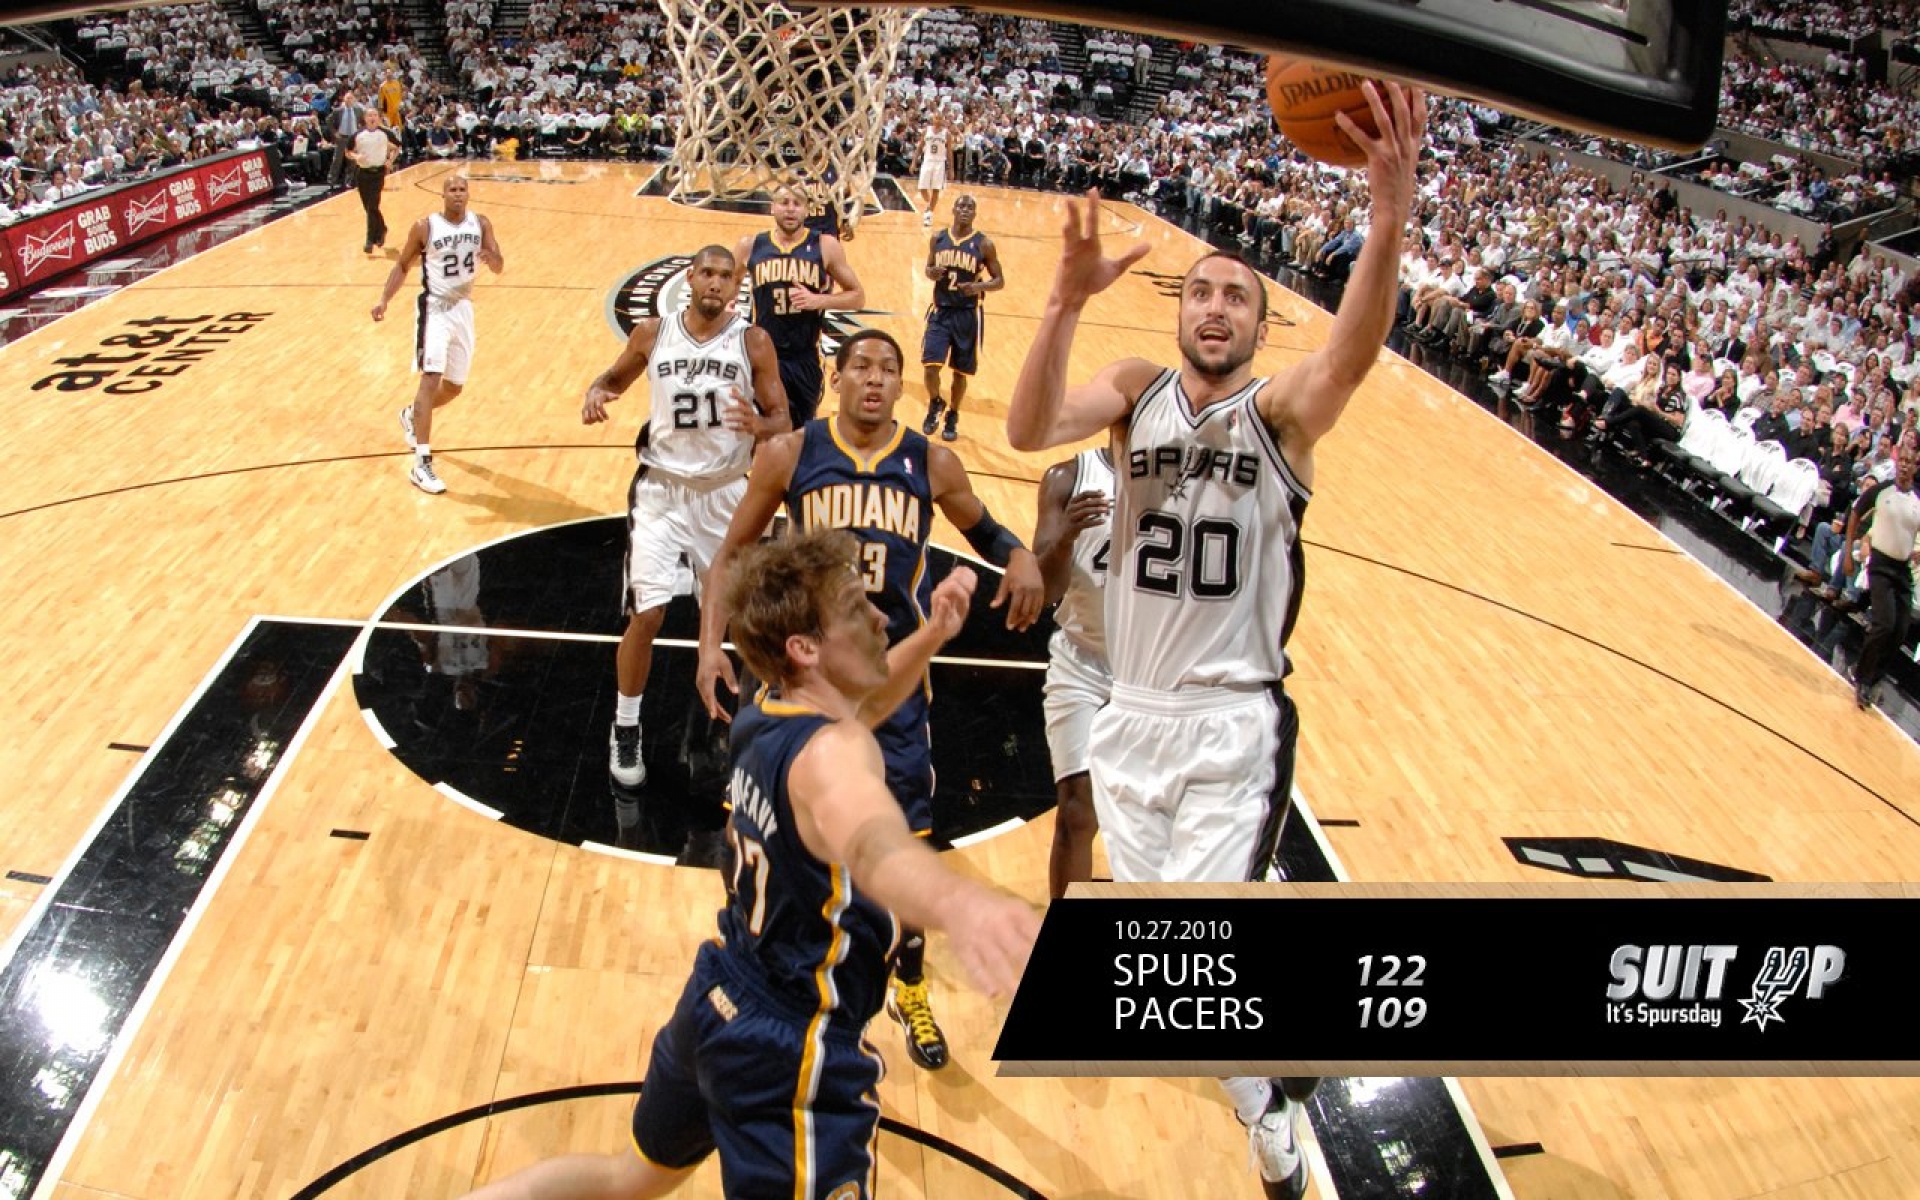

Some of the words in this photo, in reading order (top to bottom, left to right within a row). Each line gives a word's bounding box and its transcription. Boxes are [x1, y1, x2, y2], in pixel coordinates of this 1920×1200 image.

[1280, 71, 1364, 109] SPALDIN
[242, 156, 264, 173] GRAB
[168, 177, 196, 197] GRAB
[246, 176, 268, 193] BUDS
[77, 205, 112, 229] GRAB
[174, 199, 202, 220] BUDS
[17, 235, 76, 267] Budweiser
[83, 230, 118, 256] BUDS
[432, 232, 481, 250] SPURS
[443, 251, 475, 277] 24
[755, 257, 820, 289] INDIANA
[947, 271, 958, 291] 2
[30, 314, 215, 392] at&t
[102, 311, 274, 395] CENTER
[657, 357, 739, 384] SPURS
[673, 390, 722, 429] 21
[1130, 447, 1260, 497] SPURS
[801, 483, 921, 544] INDIANA
[855, 542, 888, 593] 3
[1134, 508, 1242, 600] 20
